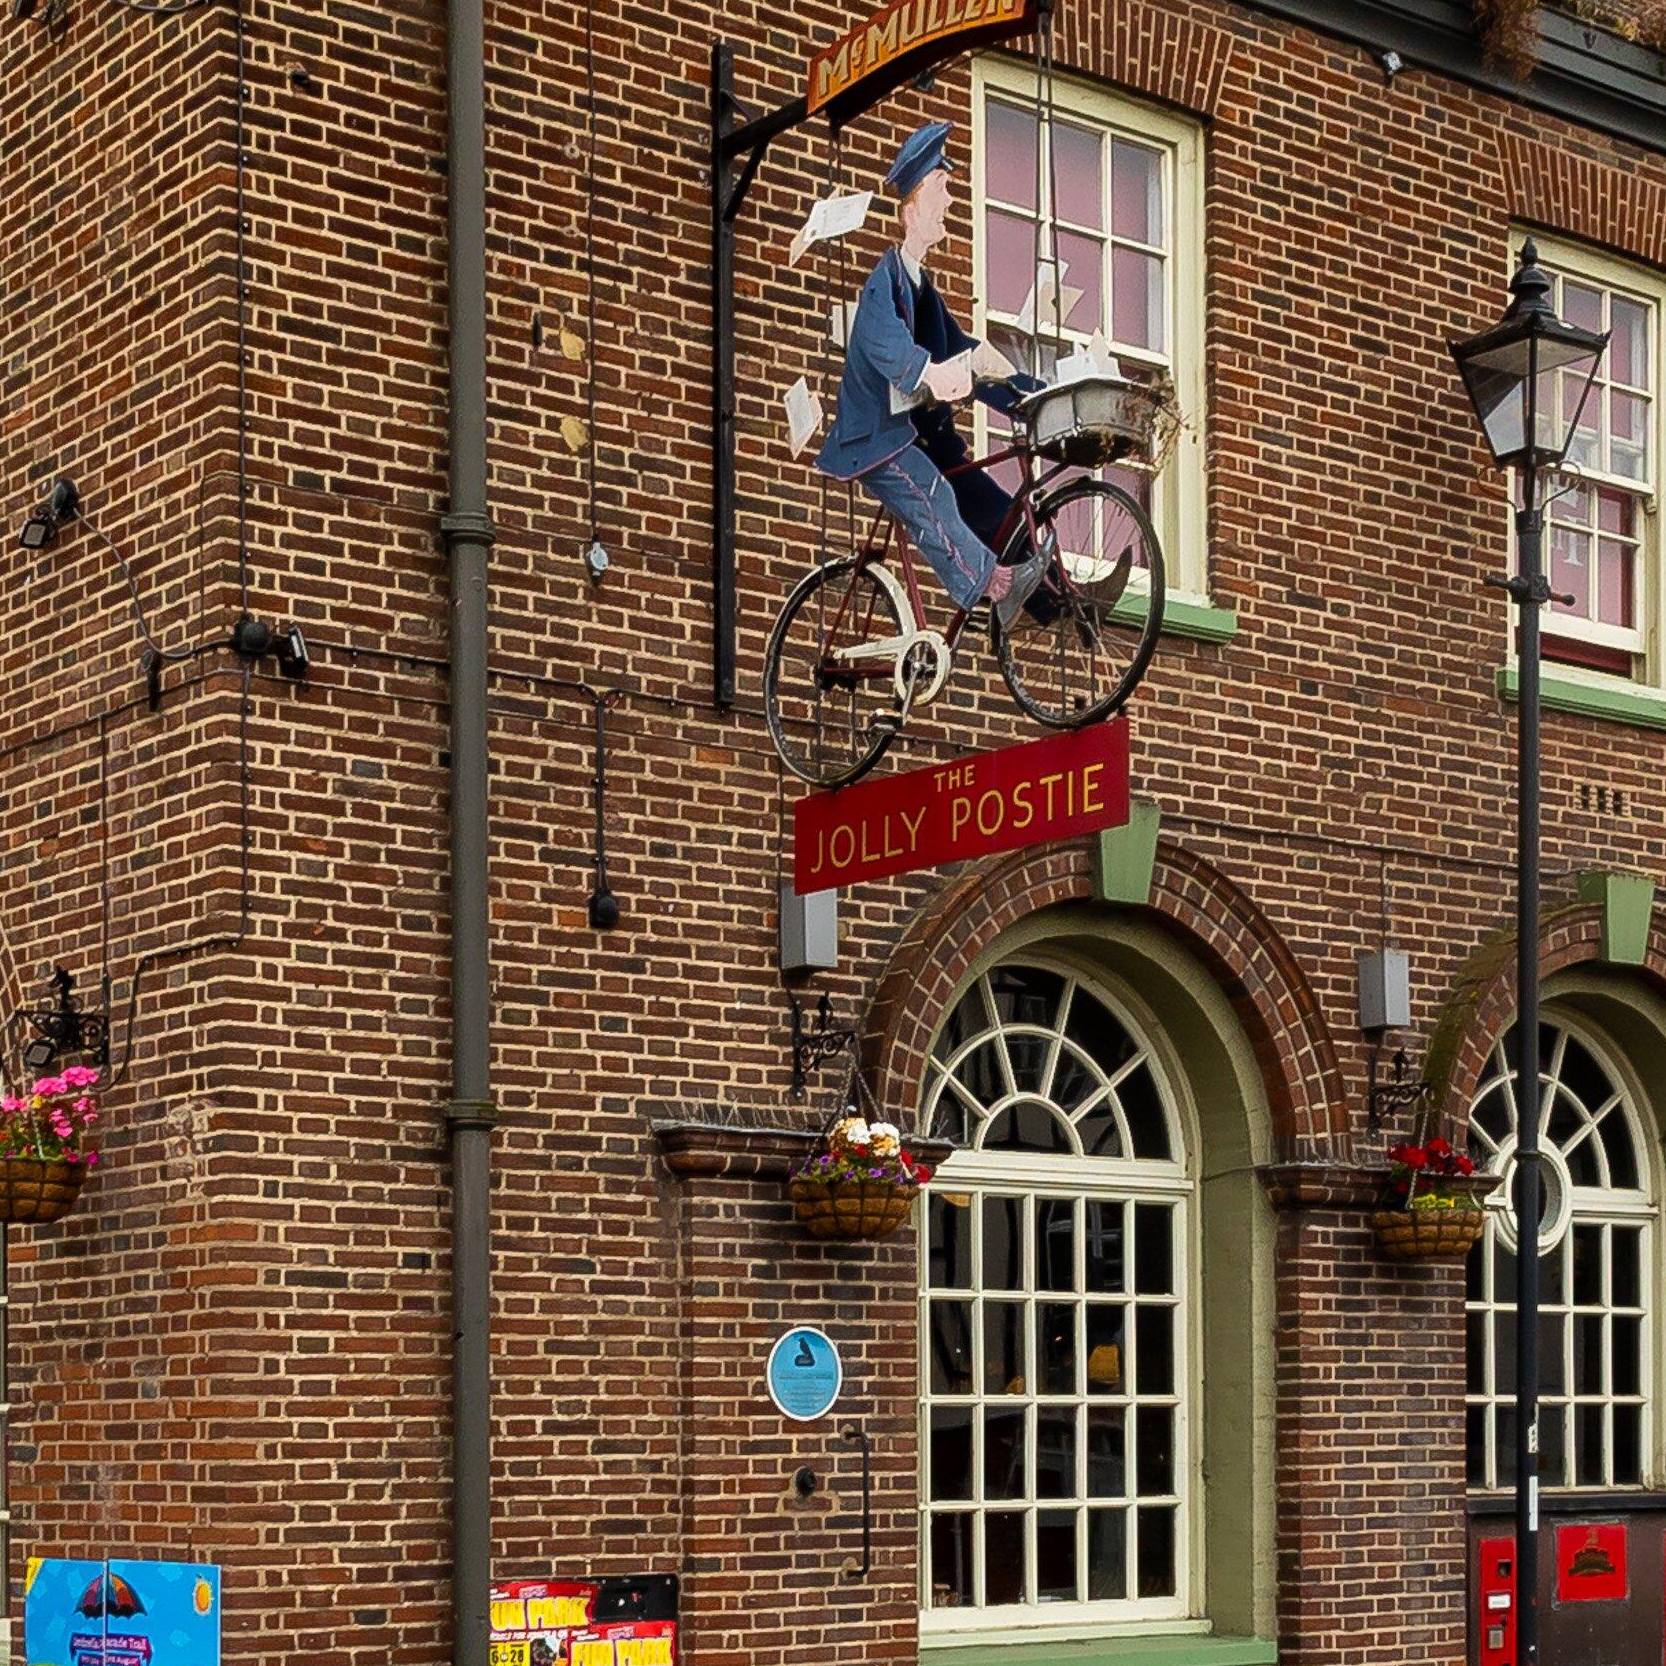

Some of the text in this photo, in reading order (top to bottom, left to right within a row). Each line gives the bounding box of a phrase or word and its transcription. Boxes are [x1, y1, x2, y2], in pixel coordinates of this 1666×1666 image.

[934, 764, 975, 793] THE
[811, 763, 1104, 873] JOLLY POSTIE
[490, 1596, 590, 1631] UN PARK
[510, 1648, 525, 1663] 28
